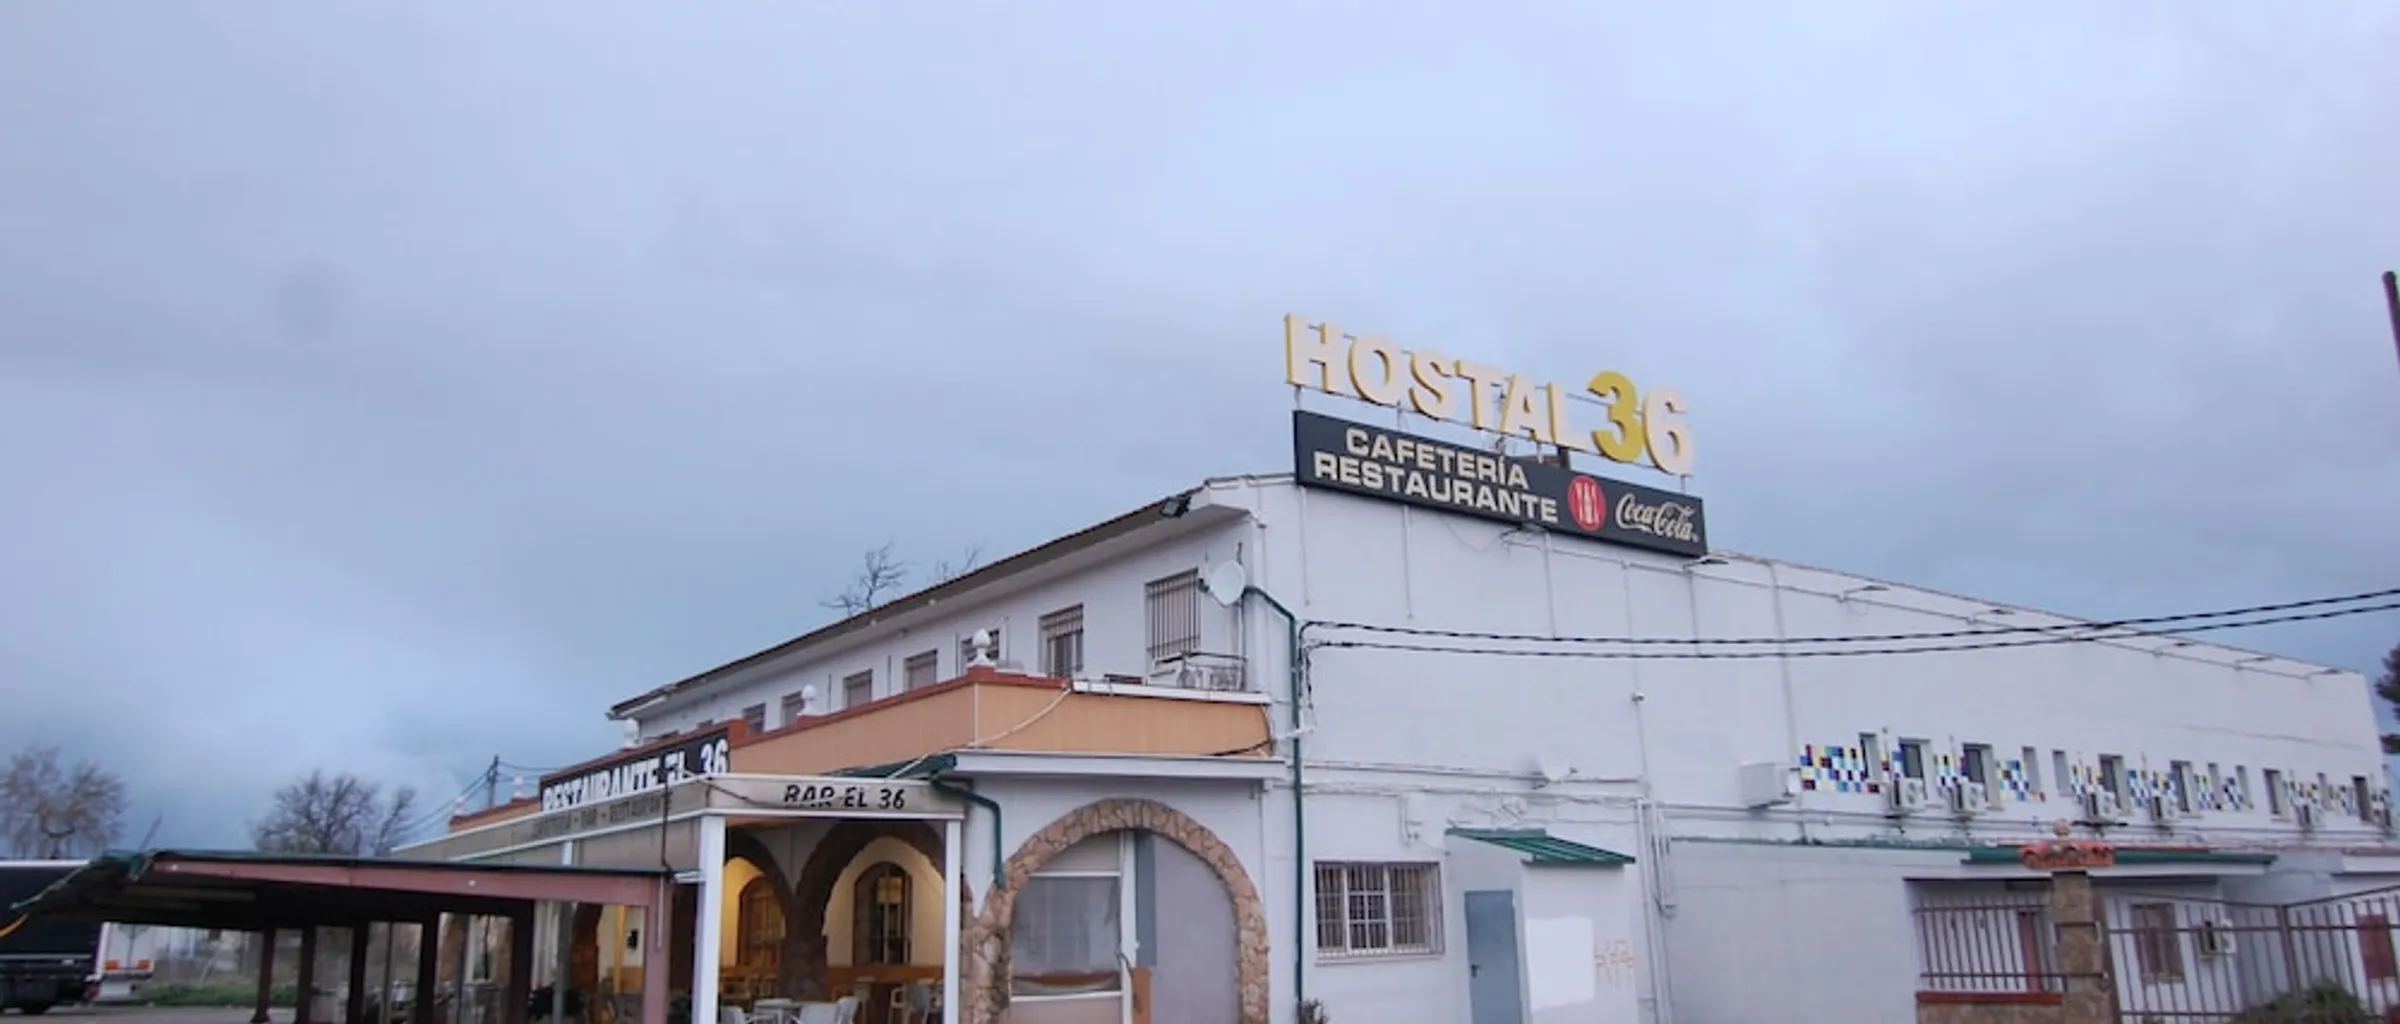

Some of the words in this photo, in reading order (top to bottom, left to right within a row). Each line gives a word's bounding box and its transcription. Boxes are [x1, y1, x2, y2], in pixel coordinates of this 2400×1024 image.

[1284, 313, 1593, 452] HOSTAL
[1588, 370, 1694, 476] 36
[1313, 451, 1559, 523] RESTAURANTE
[1346, 428, 1530, 490] CAFETERÍA
[542, 758, 661, 812] RESTAURANTE
[700, 738, 729, 775] 36
[783, 784, 835, 808] BAR
[844, 786, 868, 808] EL
[878, 788, 906, 809] 36
